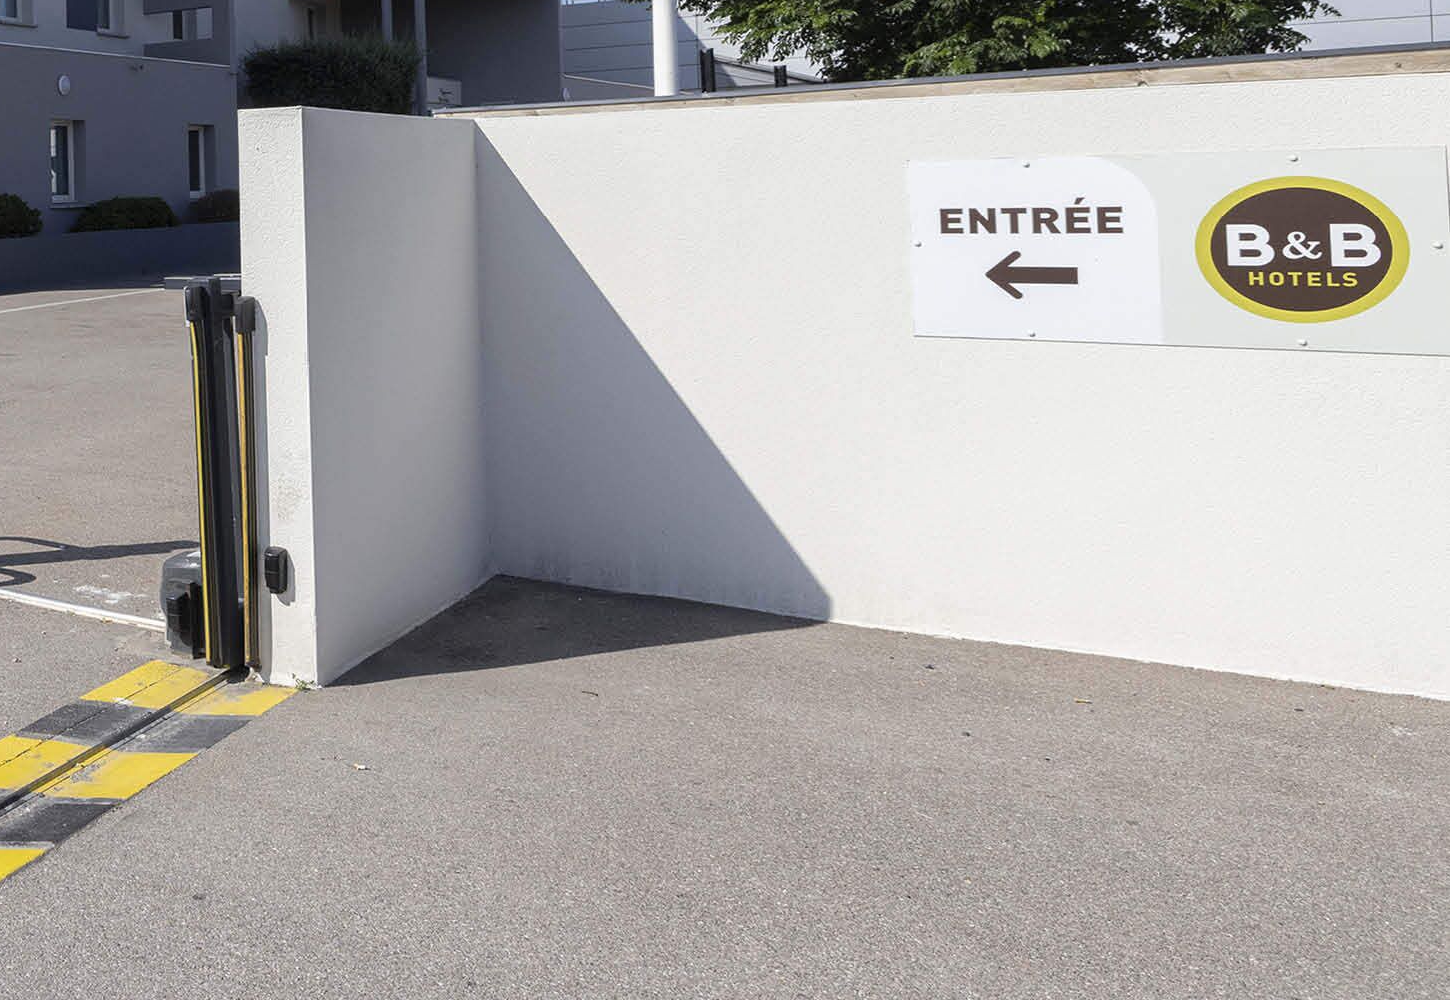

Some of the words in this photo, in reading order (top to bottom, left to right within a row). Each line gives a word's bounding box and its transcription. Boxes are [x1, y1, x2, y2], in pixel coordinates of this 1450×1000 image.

[939, 197, 1124, 234] ENTRÉE
[1225, 223, 1382, 267] B&B
[1248, 271, 1359, 287] HOTELS
